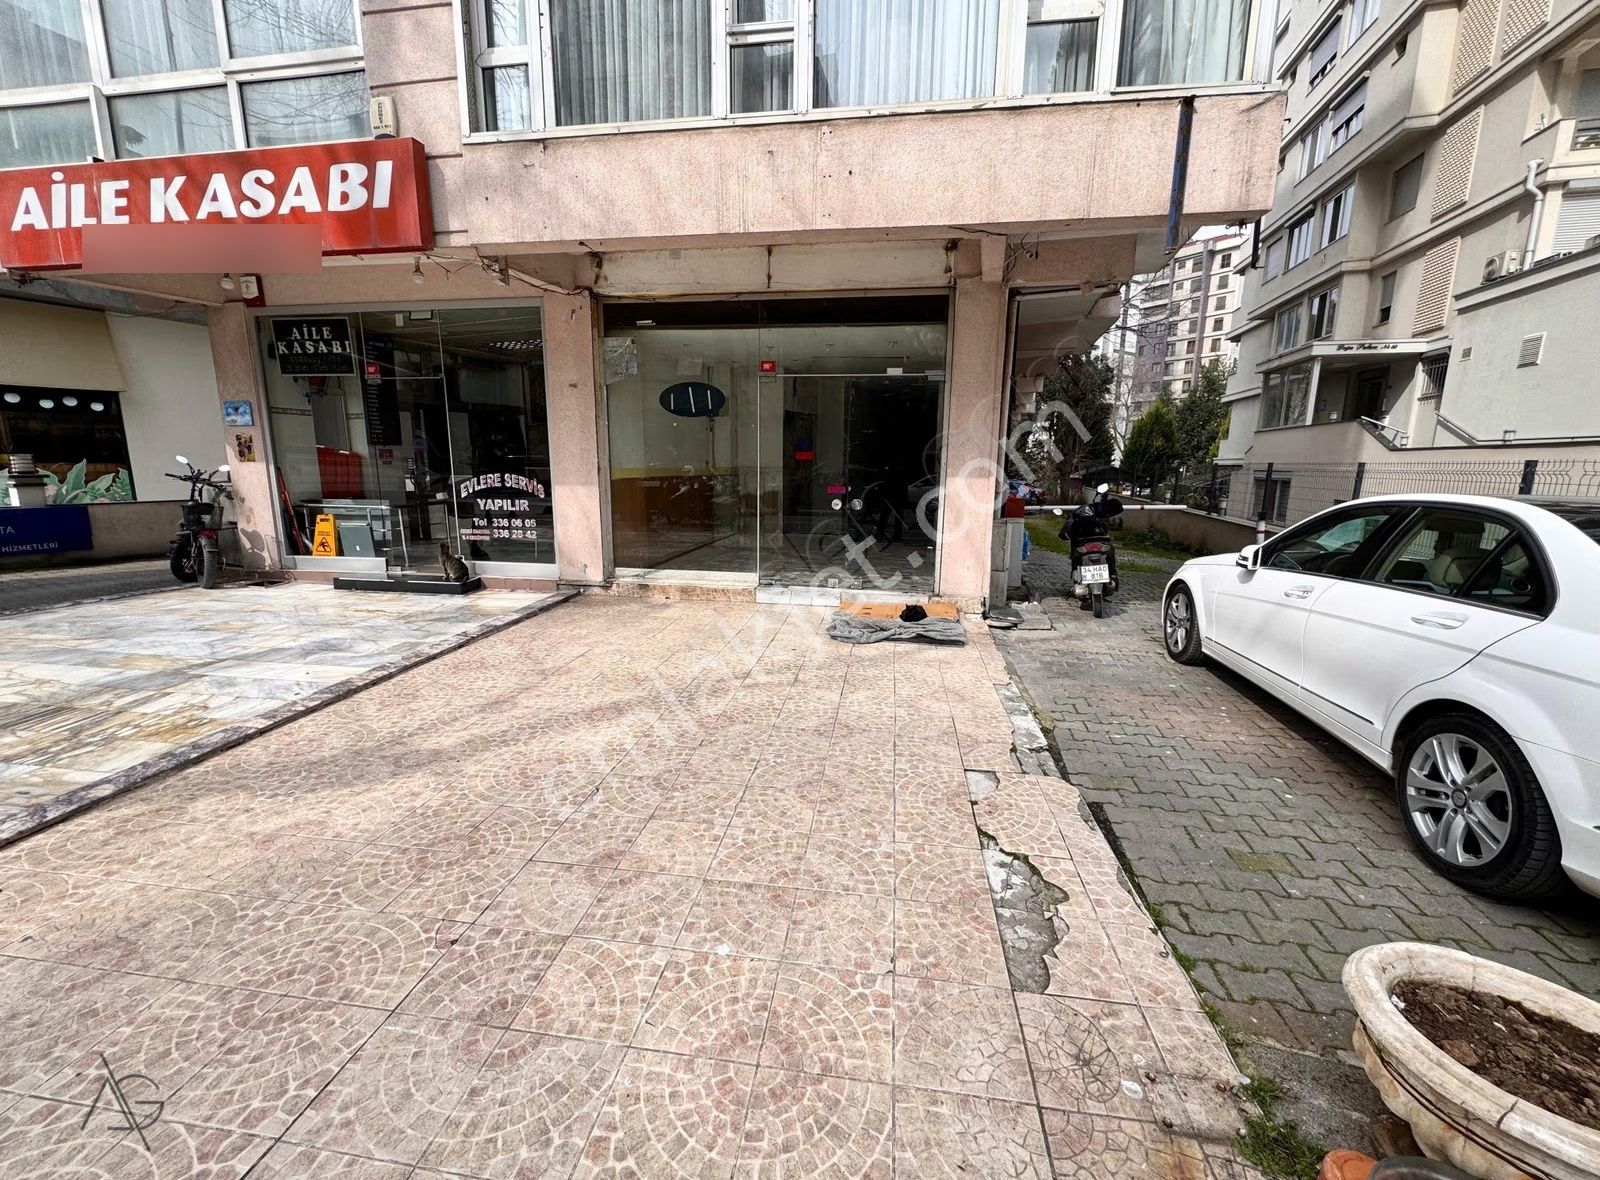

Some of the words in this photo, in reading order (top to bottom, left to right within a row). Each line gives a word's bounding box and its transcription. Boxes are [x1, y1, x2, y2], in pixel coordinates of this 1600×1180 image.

[10, 171, 130, 232] AİLE
[149, 160, 394, 223] KASABI
[292, 324, 332, 340] AİLE
[277, 341, 352, 354] KASABI
[460, 473, 502, 498] EVLERE
[504, 473, 545, 498] SERVİS
[477, 499, 529, 511] YAPILIR
[473, 518, 487, 526] Tel
[492, 519, 509, 527] 336
[511, 519, 522, 527] 06
[525, 519, 536, 527] 05
[493, 529, 509, 538] 336
[525, 530, 537, 539] 42
